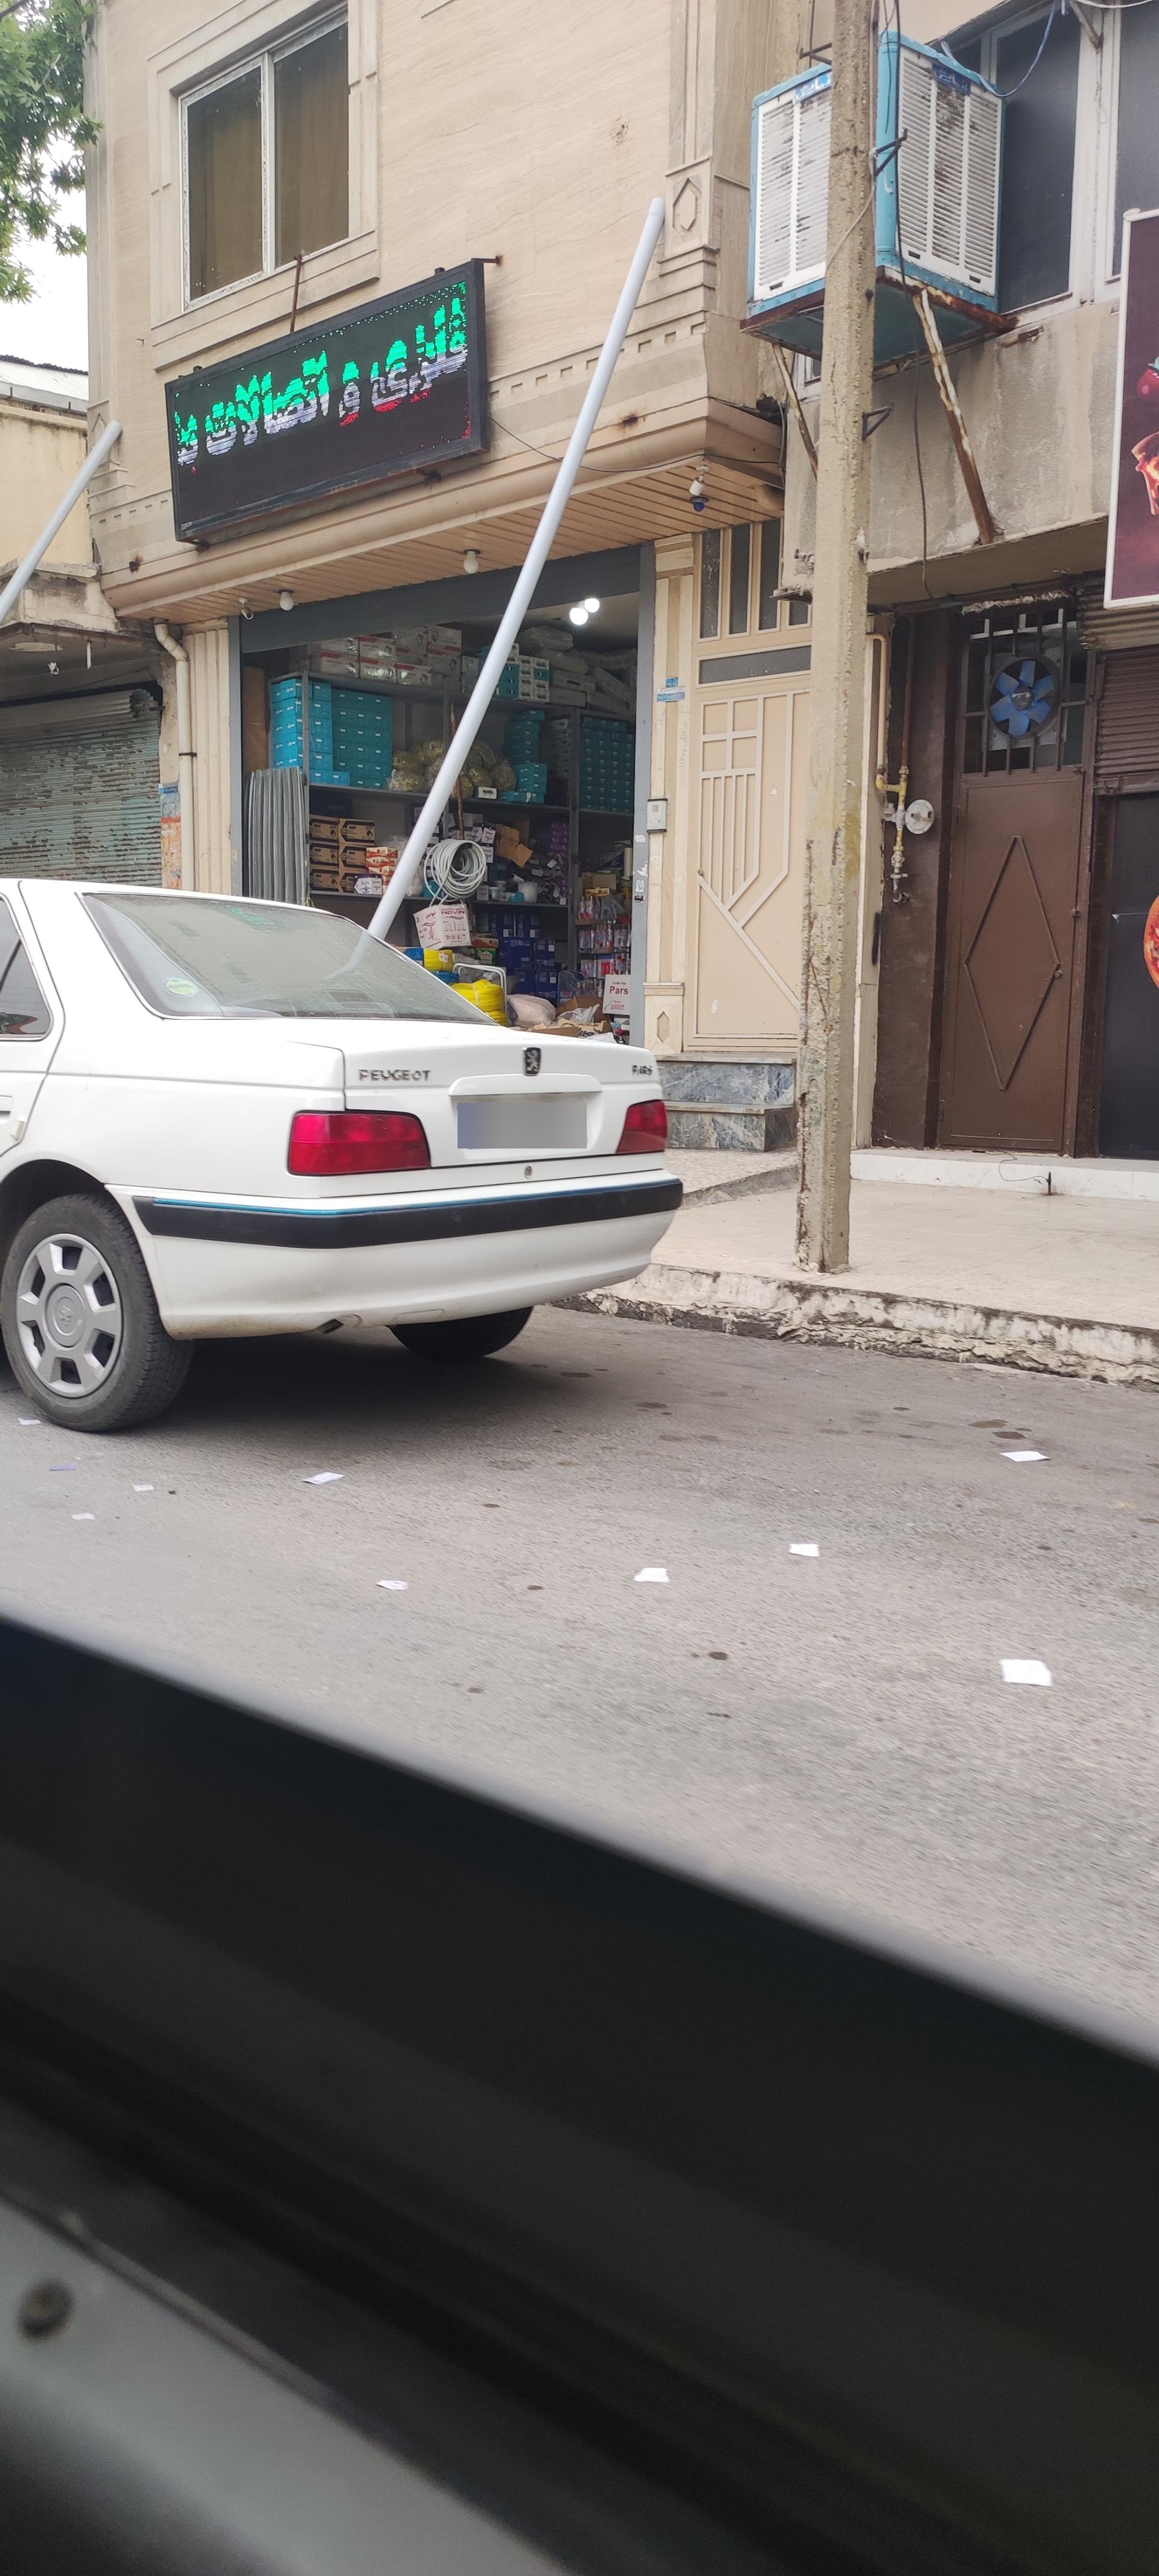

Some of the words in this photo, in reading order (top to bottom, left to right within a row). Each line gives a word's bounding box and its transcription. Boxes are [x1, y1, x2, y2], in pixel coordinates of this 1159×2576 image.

[205, 350, 330, 456] اتصالات
[338, 361, 360, 426] و
[610, 985, 628, 995] Pars
[358, 1069, 431, 1081] PEUGEOT
